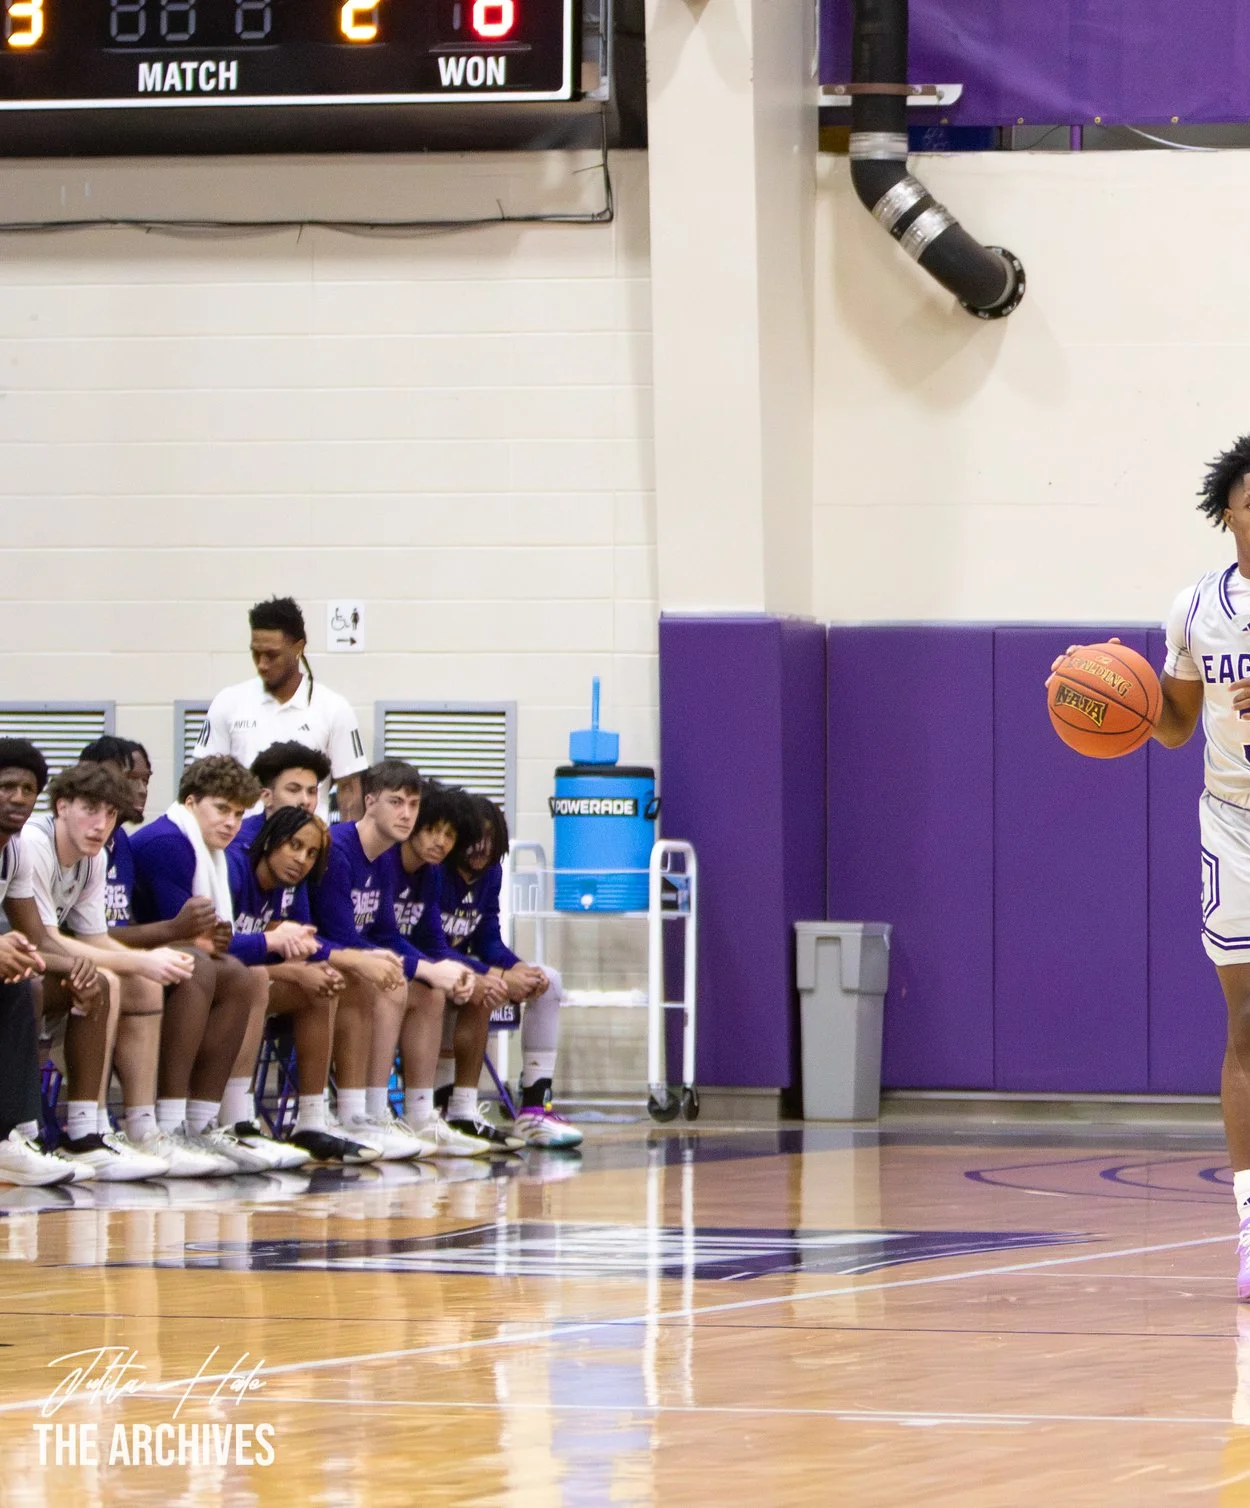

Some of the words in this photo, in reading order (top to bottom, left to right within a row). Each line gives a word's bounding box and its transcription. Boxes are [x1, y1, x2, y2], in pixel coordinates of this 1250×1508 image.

[138, 60, 238, 92] MATCH
[437, 55, 507, 88] WON
[1055, 682, 1107, 728] NAIA
[233, 719, 258, 730] AVILA
[554, 799, 635, 816] POWERADE
[489, 1005, 515, 1022] AGLES
